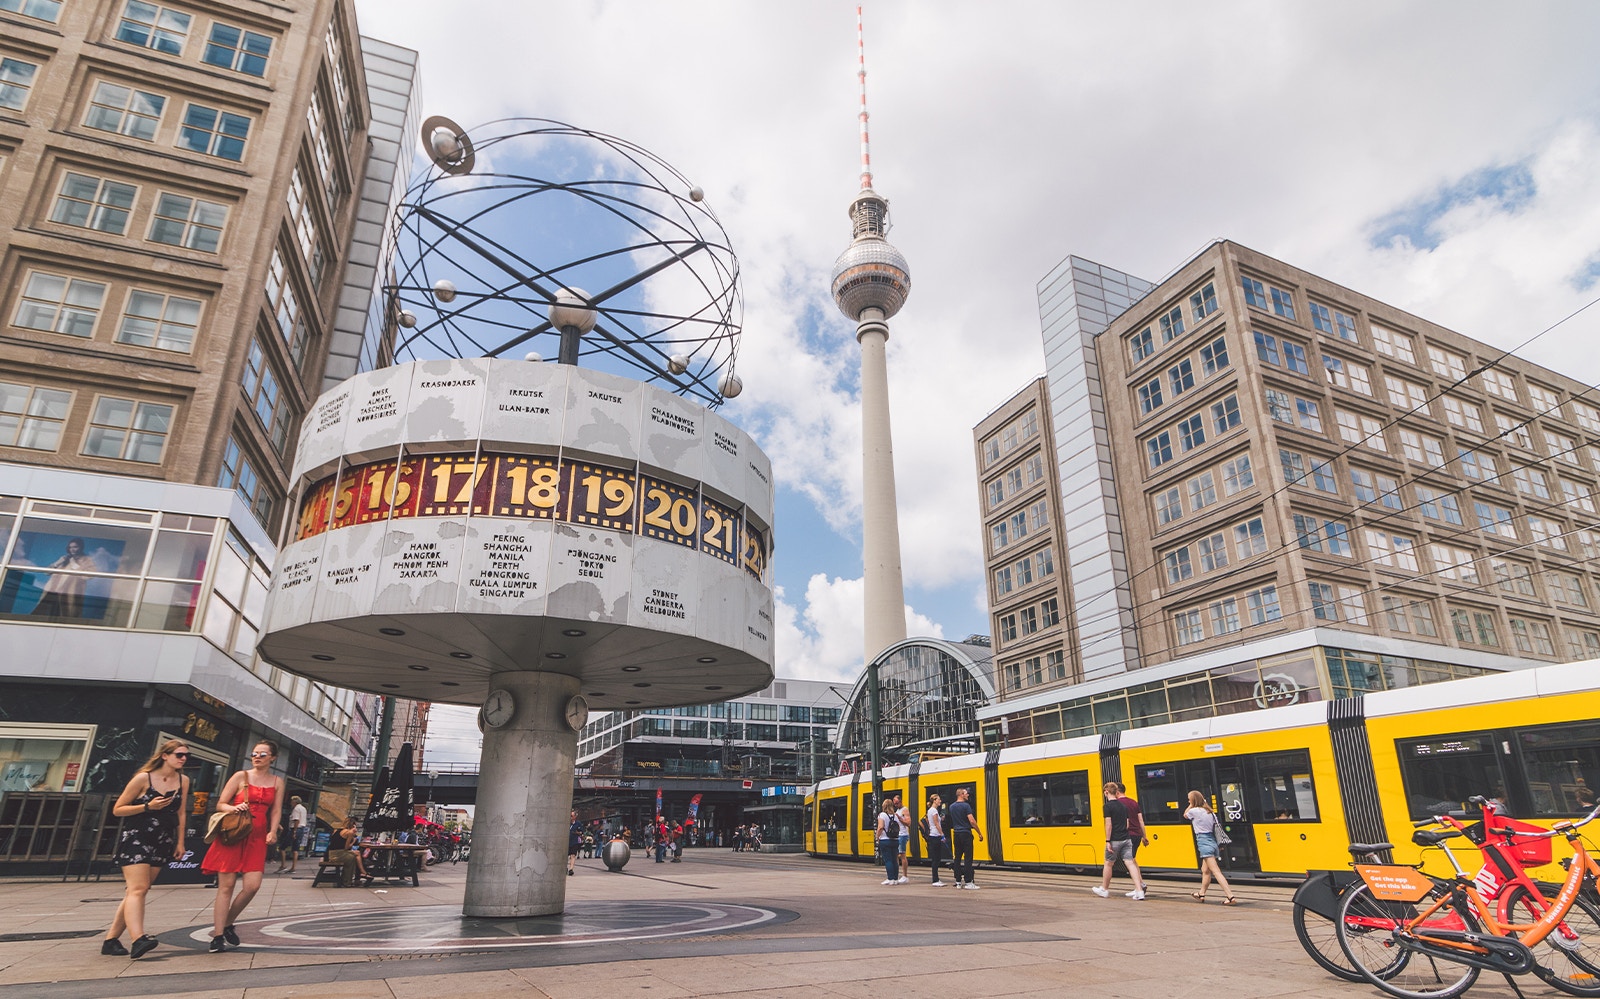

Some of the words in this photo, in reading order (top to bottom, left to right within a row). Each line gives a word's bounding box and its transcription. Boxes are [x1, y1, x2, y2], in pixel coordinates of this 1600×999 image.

[421, 379, 477, 389] KRASNOJARSK
[372, 388, 388, 397] OMSK
[509, 389, 543, 398] IRKUTSK
[588, 390, 622, 404] JAKUTSK
[367, 395, 392, 405] ALMATY
[360, 401, 397, 414] TASCHKENT
[499, 404, 550, 415] ULAN-BATOR
[356, 409, 397, 423] NOWOSIBIRSK
[651, 406, 695, 428] CHABAROWSK
[651, 414, 695, 435] WLADIWOSTOK
[714, 431, 737, 450] MAGADAN
[323, 478, 355, 524] 15
[367, 466, 413, 509] 16
[431, 464, 488, 502] 17
[507, 466, 561, 508] 18
[582, 475, 634, 517] 19
[645, 488, 697, 536] 20
[703, 509, 733, 554] 21
[493, 534, 525, 543] PEKING
[410, 543, 438, 551] HANOI
[483, 543, 532, 553] SHANGHAI
[403, 551, 441, 560] BANGKOK
[488, 552, 525, 561] MANILA
[392, 560, 423, 569] PHNOM
[426, 560, 449, 569] PENH
[492, 561, 520, 570] PERTH
[579, 560, 604, 570] TOKYO
[327, 567, 354, 578] RANGUN
[399, 570, 438, 579] JAKARTA
[480, 570, 530, 580] HONGKONG
[578, 569, 604, 579] SEOUL
[335, 575, 359, 585] DHAKA
[469, 579, 499, 588] KUALA
[502, 580, 538, 590] LUMPUR
[479, 589, 525, 599] SINGAPUR
[652, 589, 678, 599] SYDNEY
[645, 596, 685, 611] CANBERRA
[643, 604, 686, 620] MELBOURNE
[1546, 902, 1564, 924] DONKEY
[1566, 866, 1581, 895] REPUBLIC
